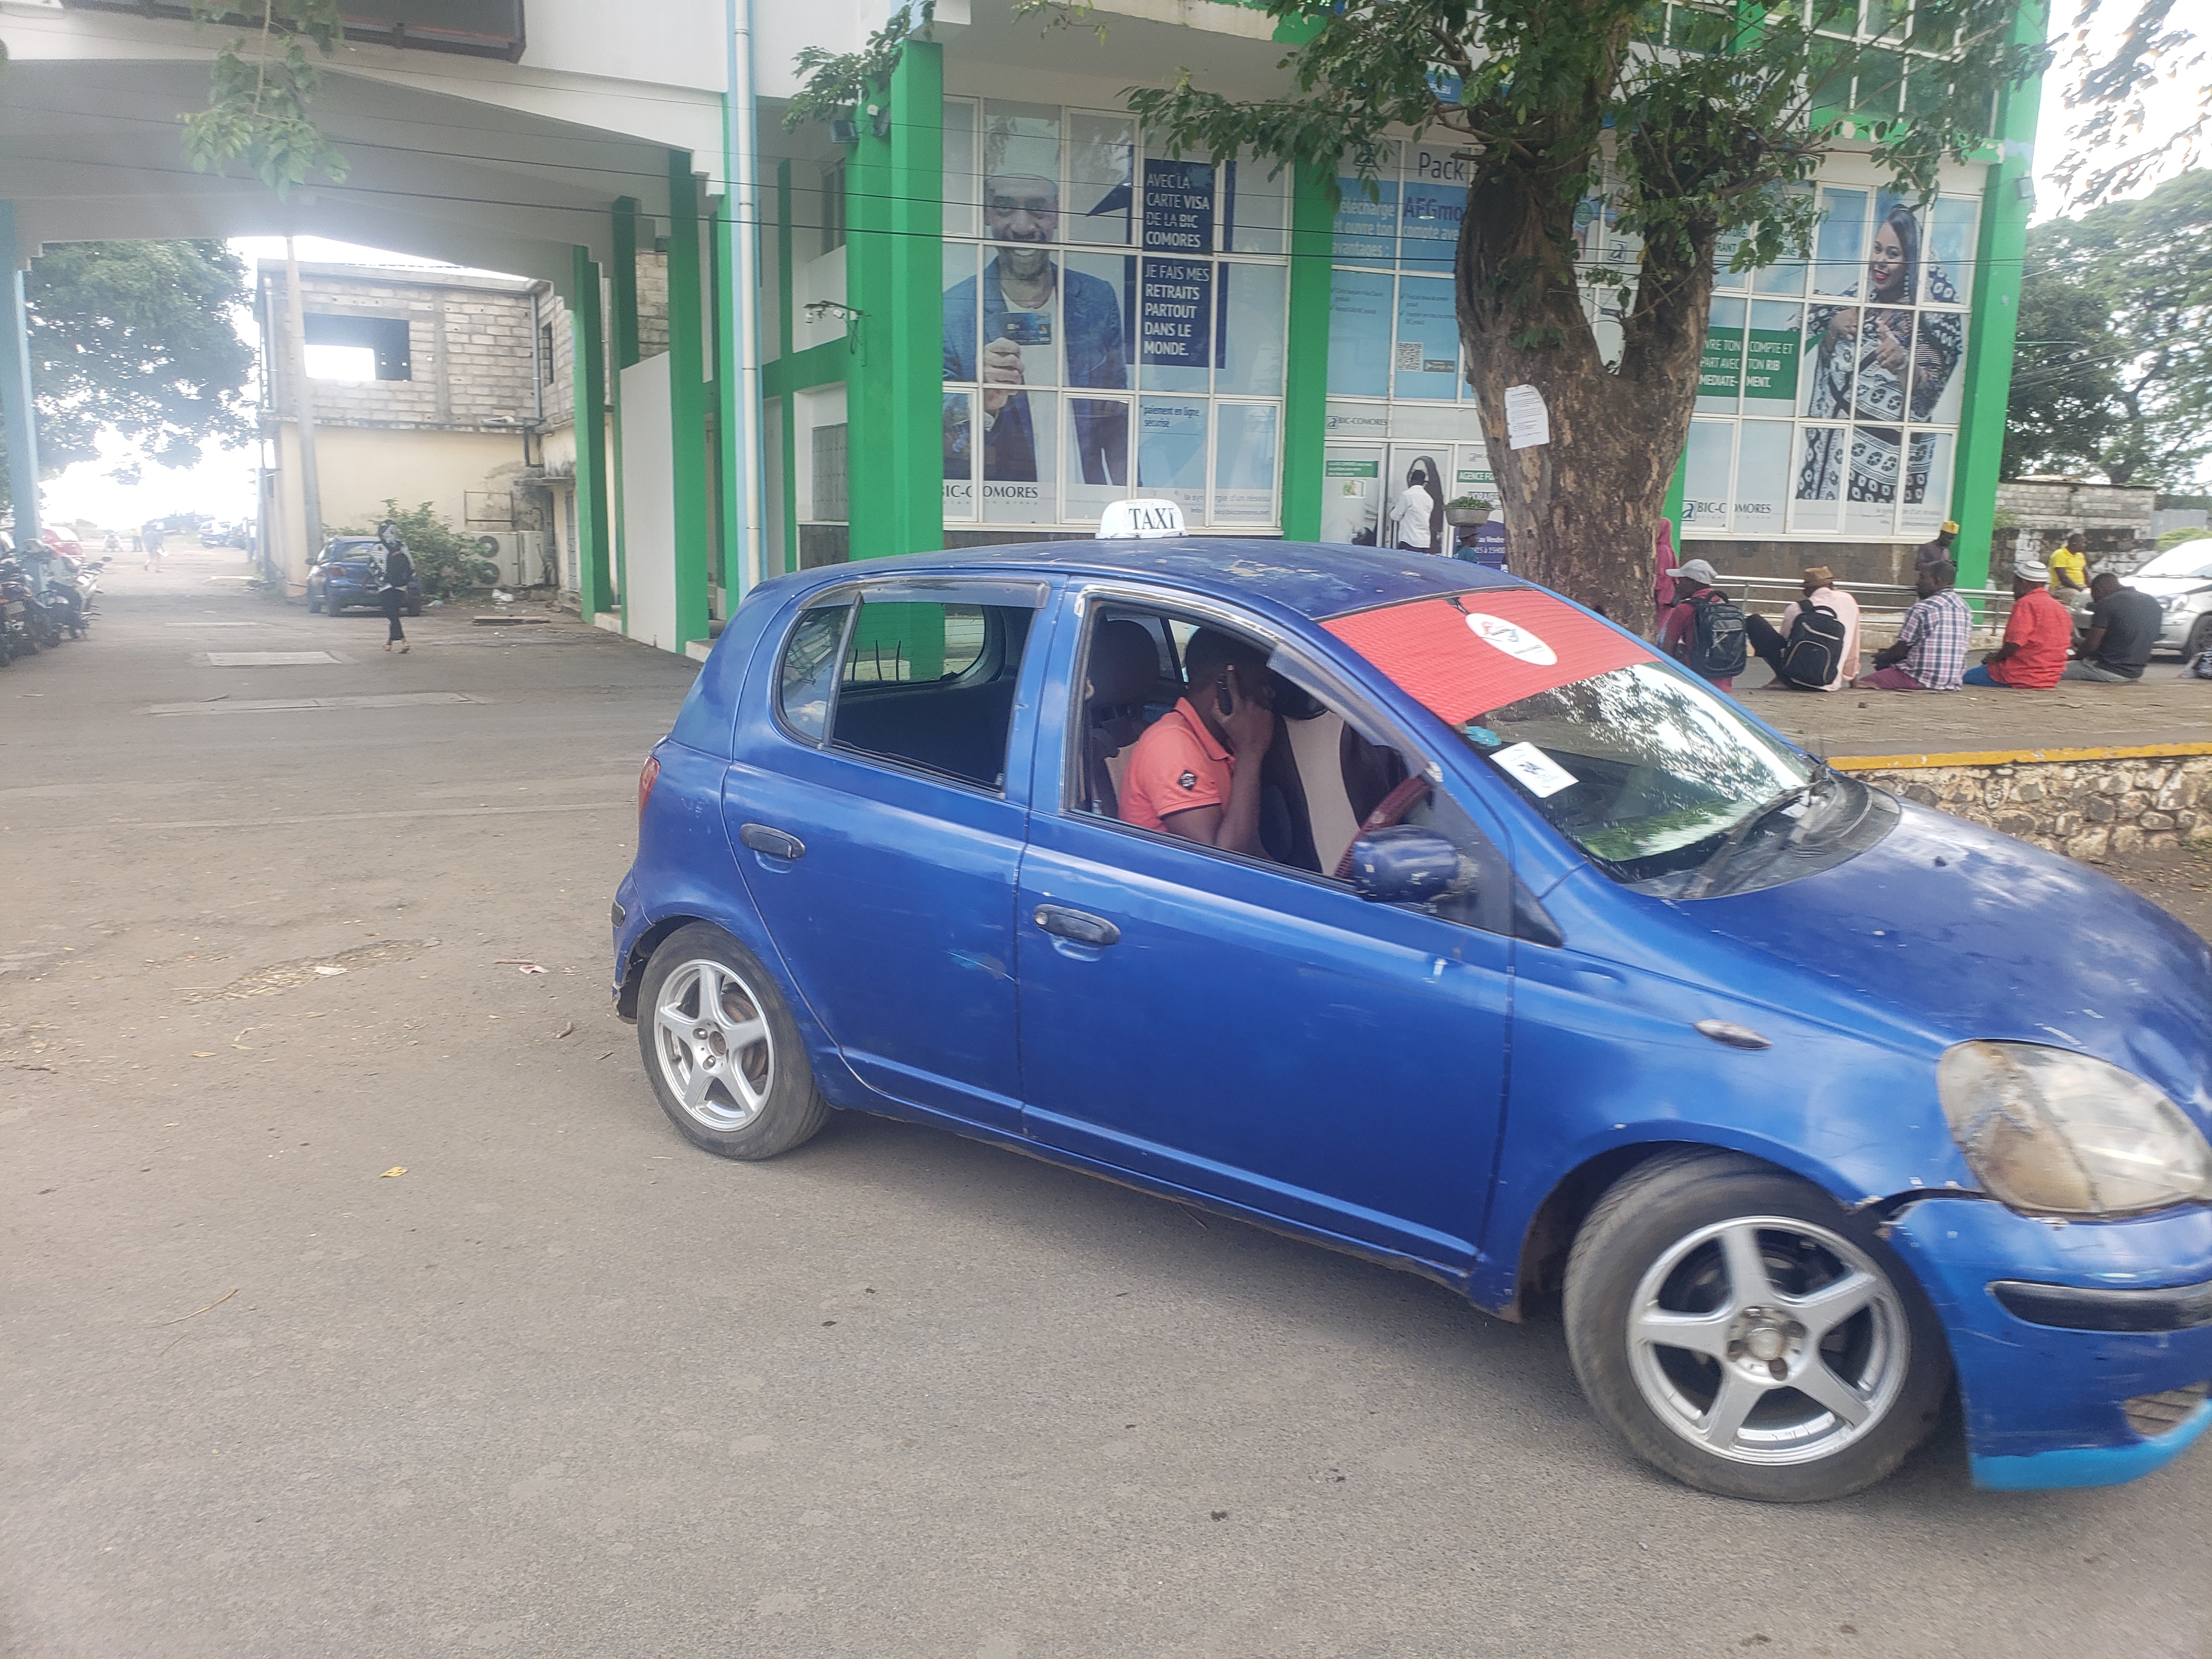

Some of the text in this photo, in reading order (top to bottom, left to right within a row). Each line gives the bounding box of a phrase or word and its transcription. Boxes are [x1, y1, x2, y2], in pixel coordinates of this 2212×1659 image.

[1419, 152, 1464, 180] Pack
[1146, 173, 1190, 189] AVEC LA
[1146, 193, 1210, 210] CARTE VISA
[1404, 197, 1464, 221] AFGmo
[1146, 212, 1198, 228] DE LA BIC
[1146, 231, 1201, 247] COMORES
[1144, 264, 1210, 281] JE FAIS MES
[1145, 284, 1200, 300] RETRAITS
[1144, 302, 1198, 318] PARTOUT
[1144, 321, 1192, 337] DANS LE
[1144, 341, 1189, 356] MONDE.
[1705, 339, 1794, 354] VRE TON COMPTE ET
[1700, 357, 1781, 371] PART AVEC TON RIB
[942, 485, 1038, 499] IC-COMORES
[1128, 508, 1176, 530] TAXI
